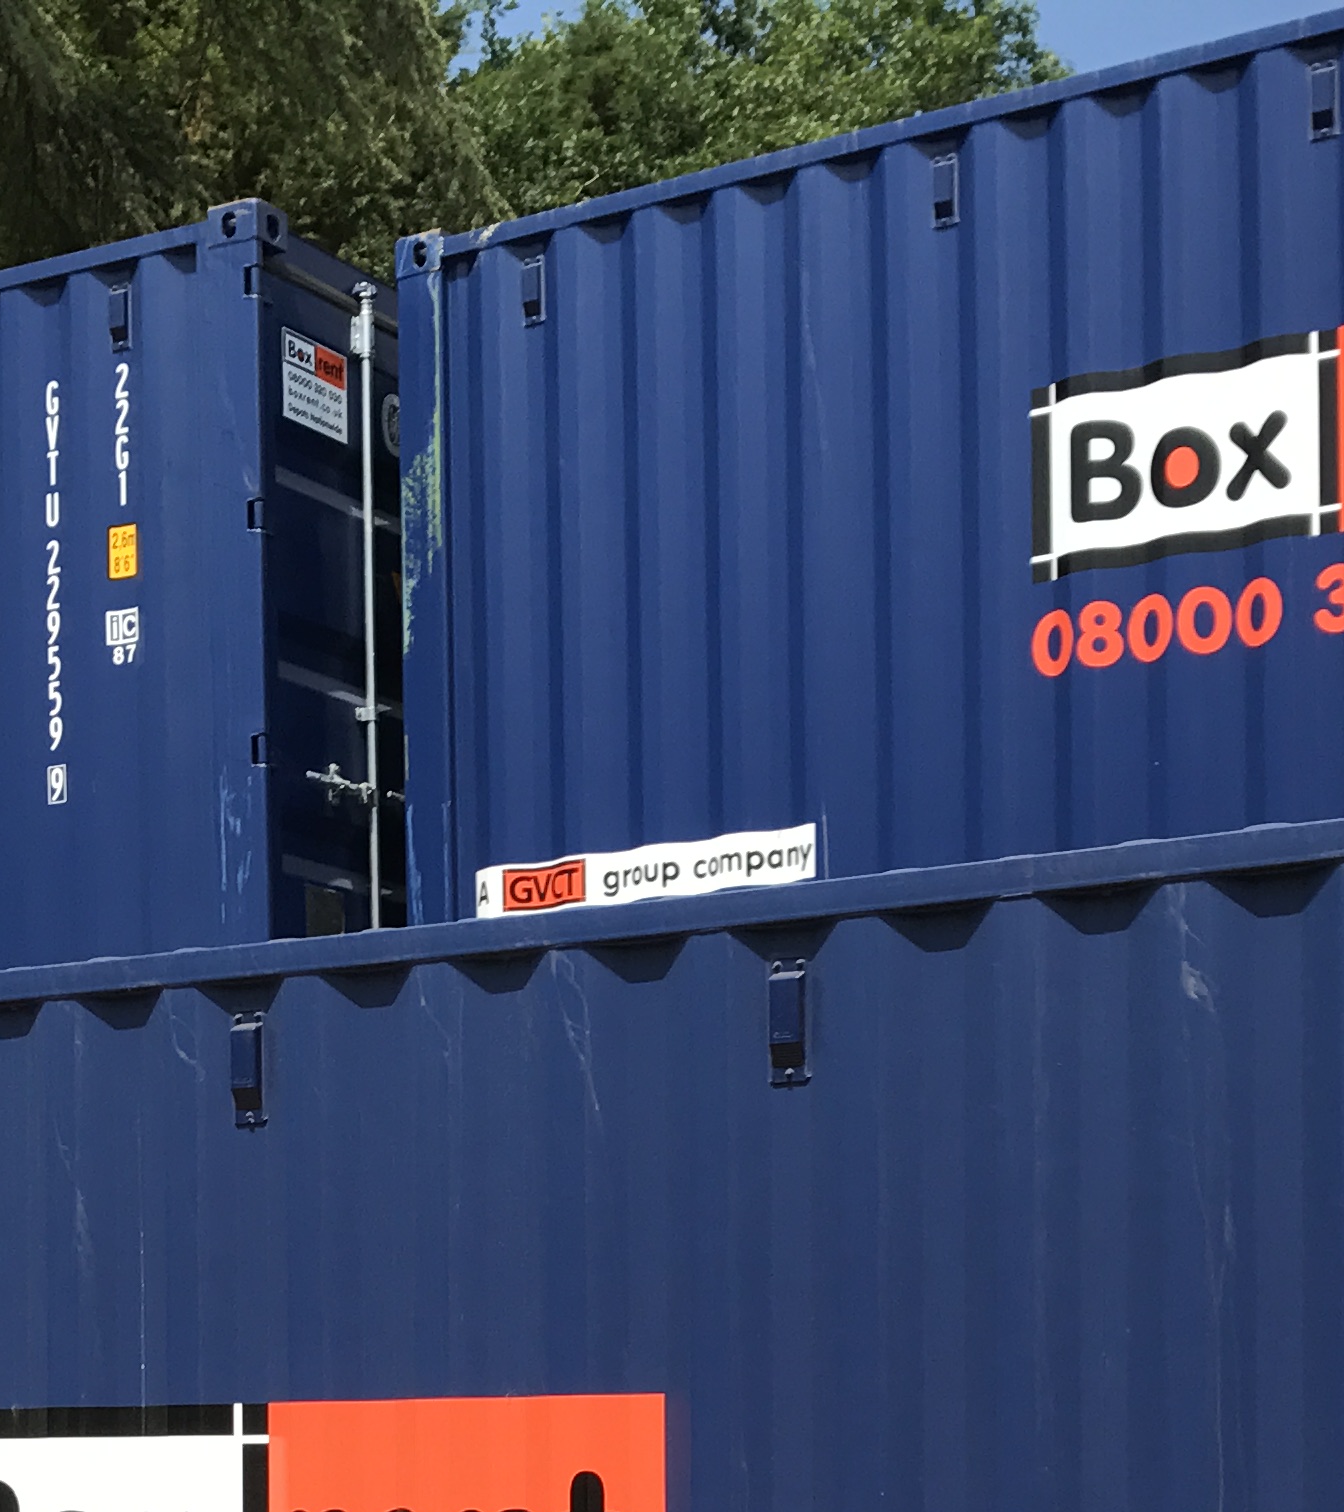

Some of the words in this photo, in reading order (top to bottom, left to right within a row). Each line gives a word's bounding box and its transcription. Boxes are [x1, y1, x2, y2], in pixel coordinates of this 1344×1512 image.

[288, 339, 313, 366] Box
[317, 358, 343, 381] rent
[45, 380, 60, 528] GVTU
[114, 362, 130, 506] 22G1
[1068, 408, 1290, 524] Box
[45, 539, 63, 751] 229559
[112, 644, 137, 666] 87
[1031, 577, 1283, 678] 08000
[50, 770, 64, 799] 9
[478, 881, 489, 906] A
[603, 859, 680, 897] group
[693, 842, 813, 879] company
